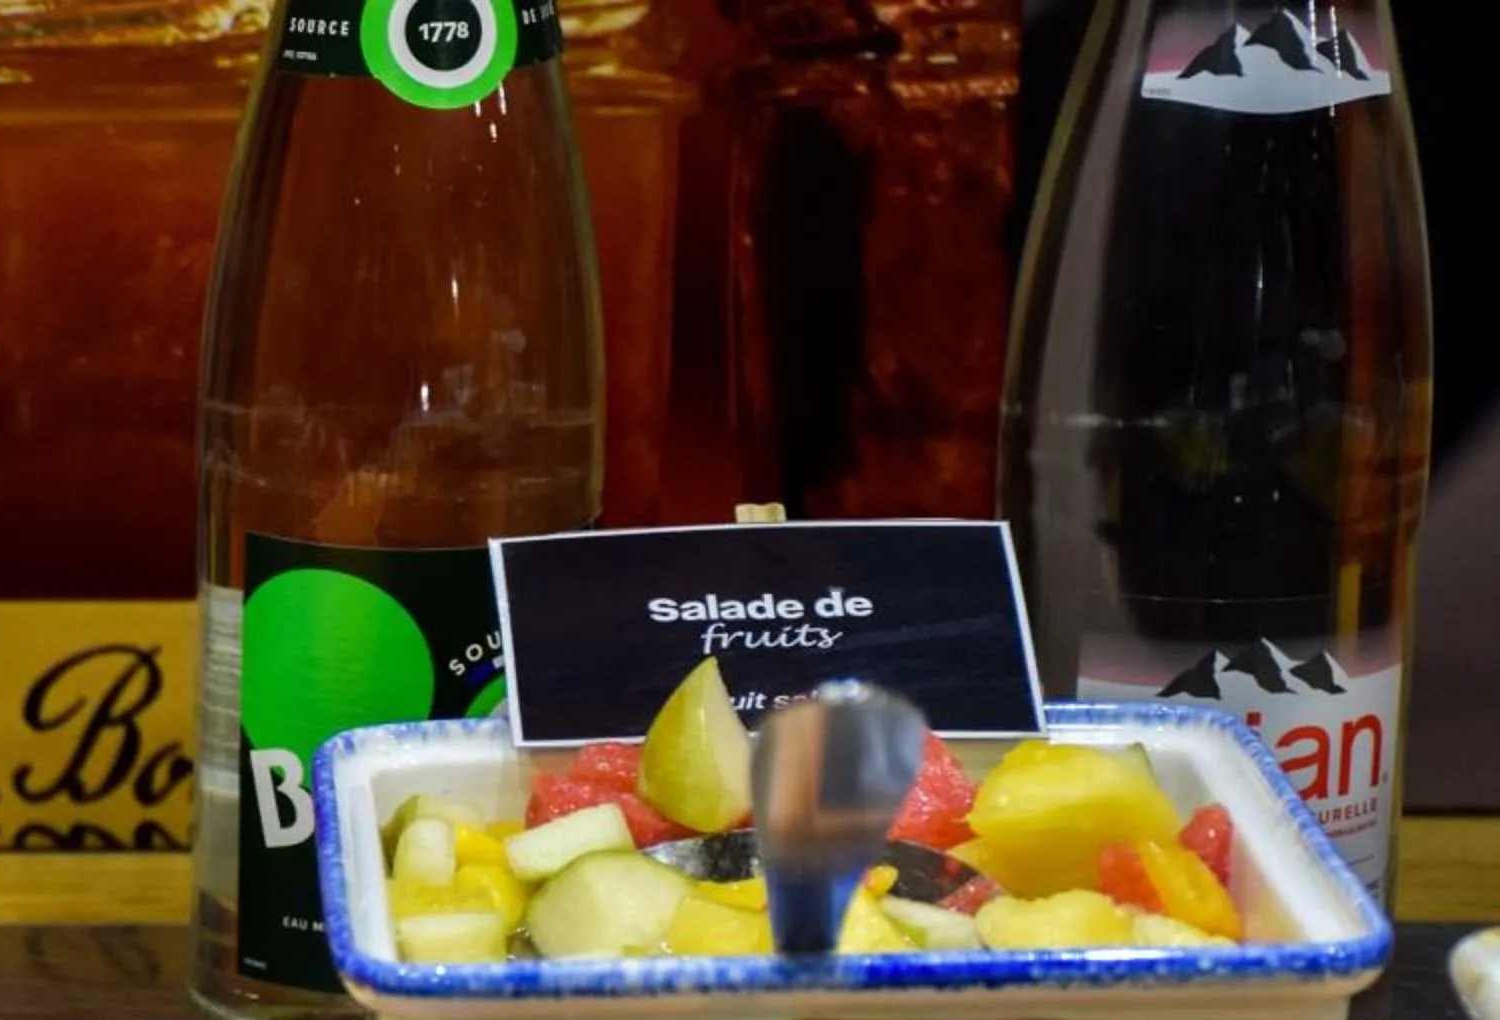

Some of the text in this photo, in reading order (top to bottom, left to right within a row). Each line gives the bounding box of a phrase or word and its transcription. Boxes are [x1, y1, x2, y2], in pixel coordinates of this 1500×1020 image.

[288, 16, 350, 36] SOURCE
[418, 21, 470, 43] 1778
[648, 588, 874, 622] Salade de
[448, 630, 501, 676] SOU
[700, 622, 844, 655] fruits
[728, 691, 765, 711] uit
[12, 643, 193, 808] Bo
[249, 747, 317, 850] B
[1317, 797, 1378, 826] URELLE
[281, 915, 309, 931] EAU
